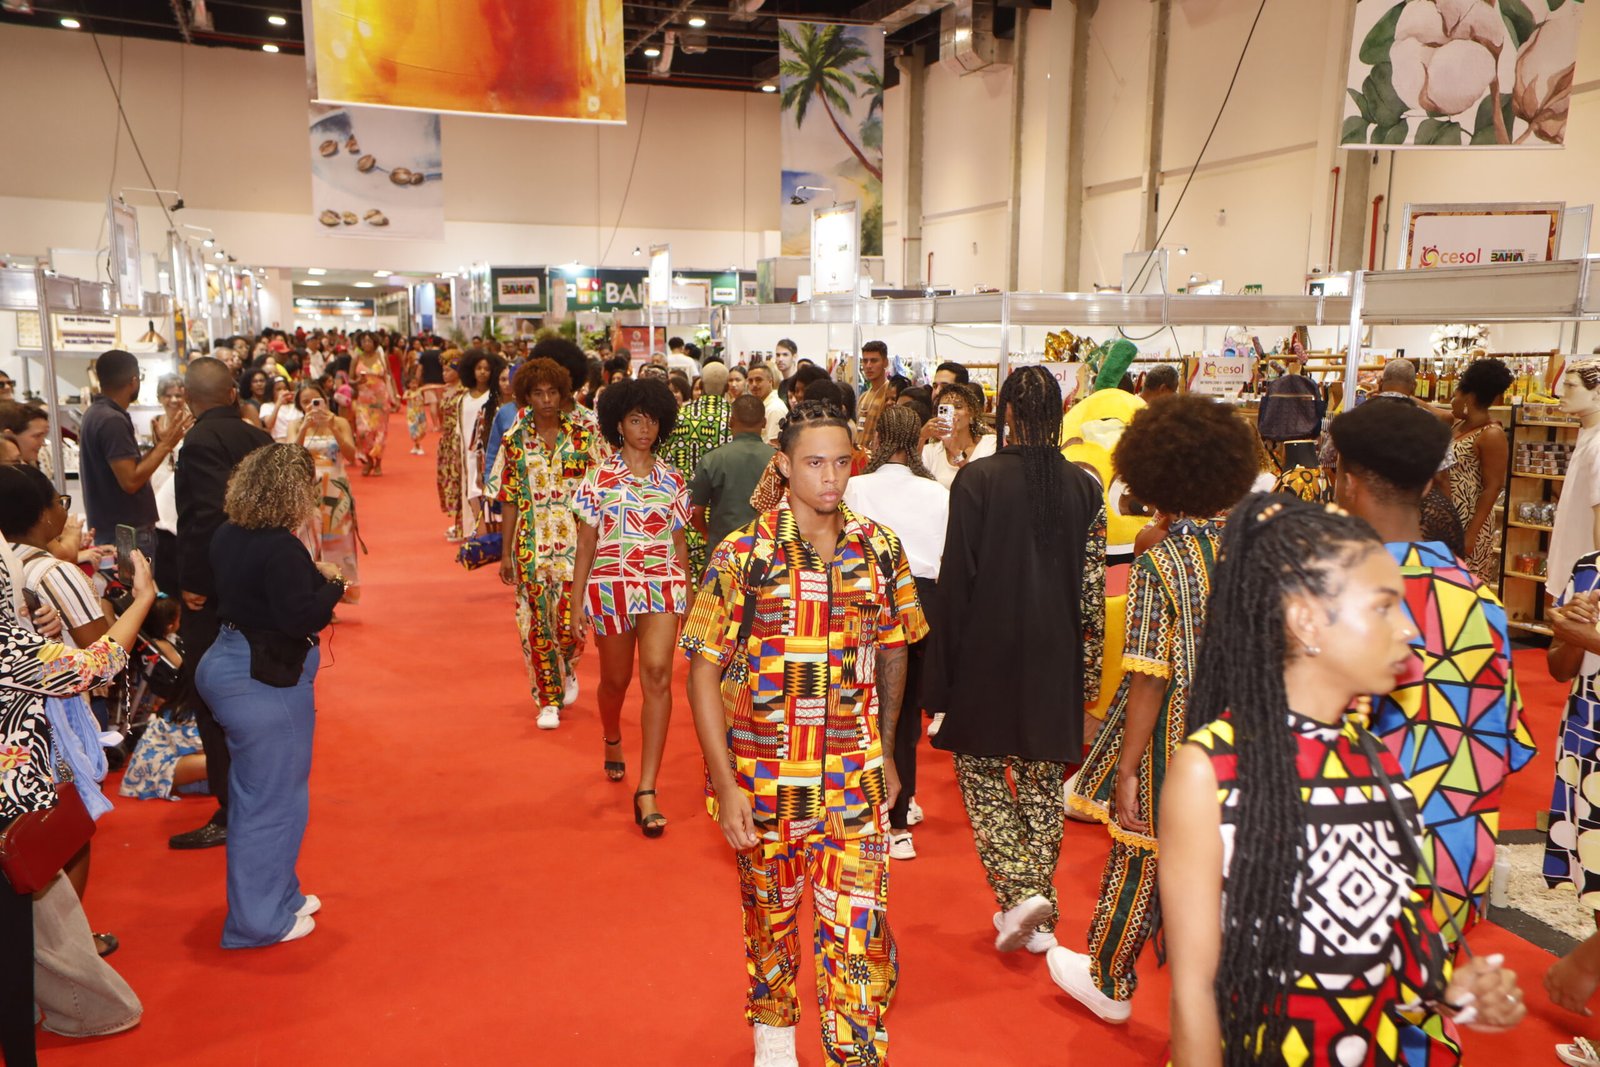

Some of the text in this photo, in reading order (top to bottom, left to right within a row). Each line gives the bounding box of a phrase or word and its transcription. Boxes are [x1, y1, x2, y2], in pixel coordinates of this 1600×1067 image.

[1440, 247, 1482, 264] cesol
[1490, 252, 1524, 262] BAHIA
[1217, 363, 1244, 374] cesol
